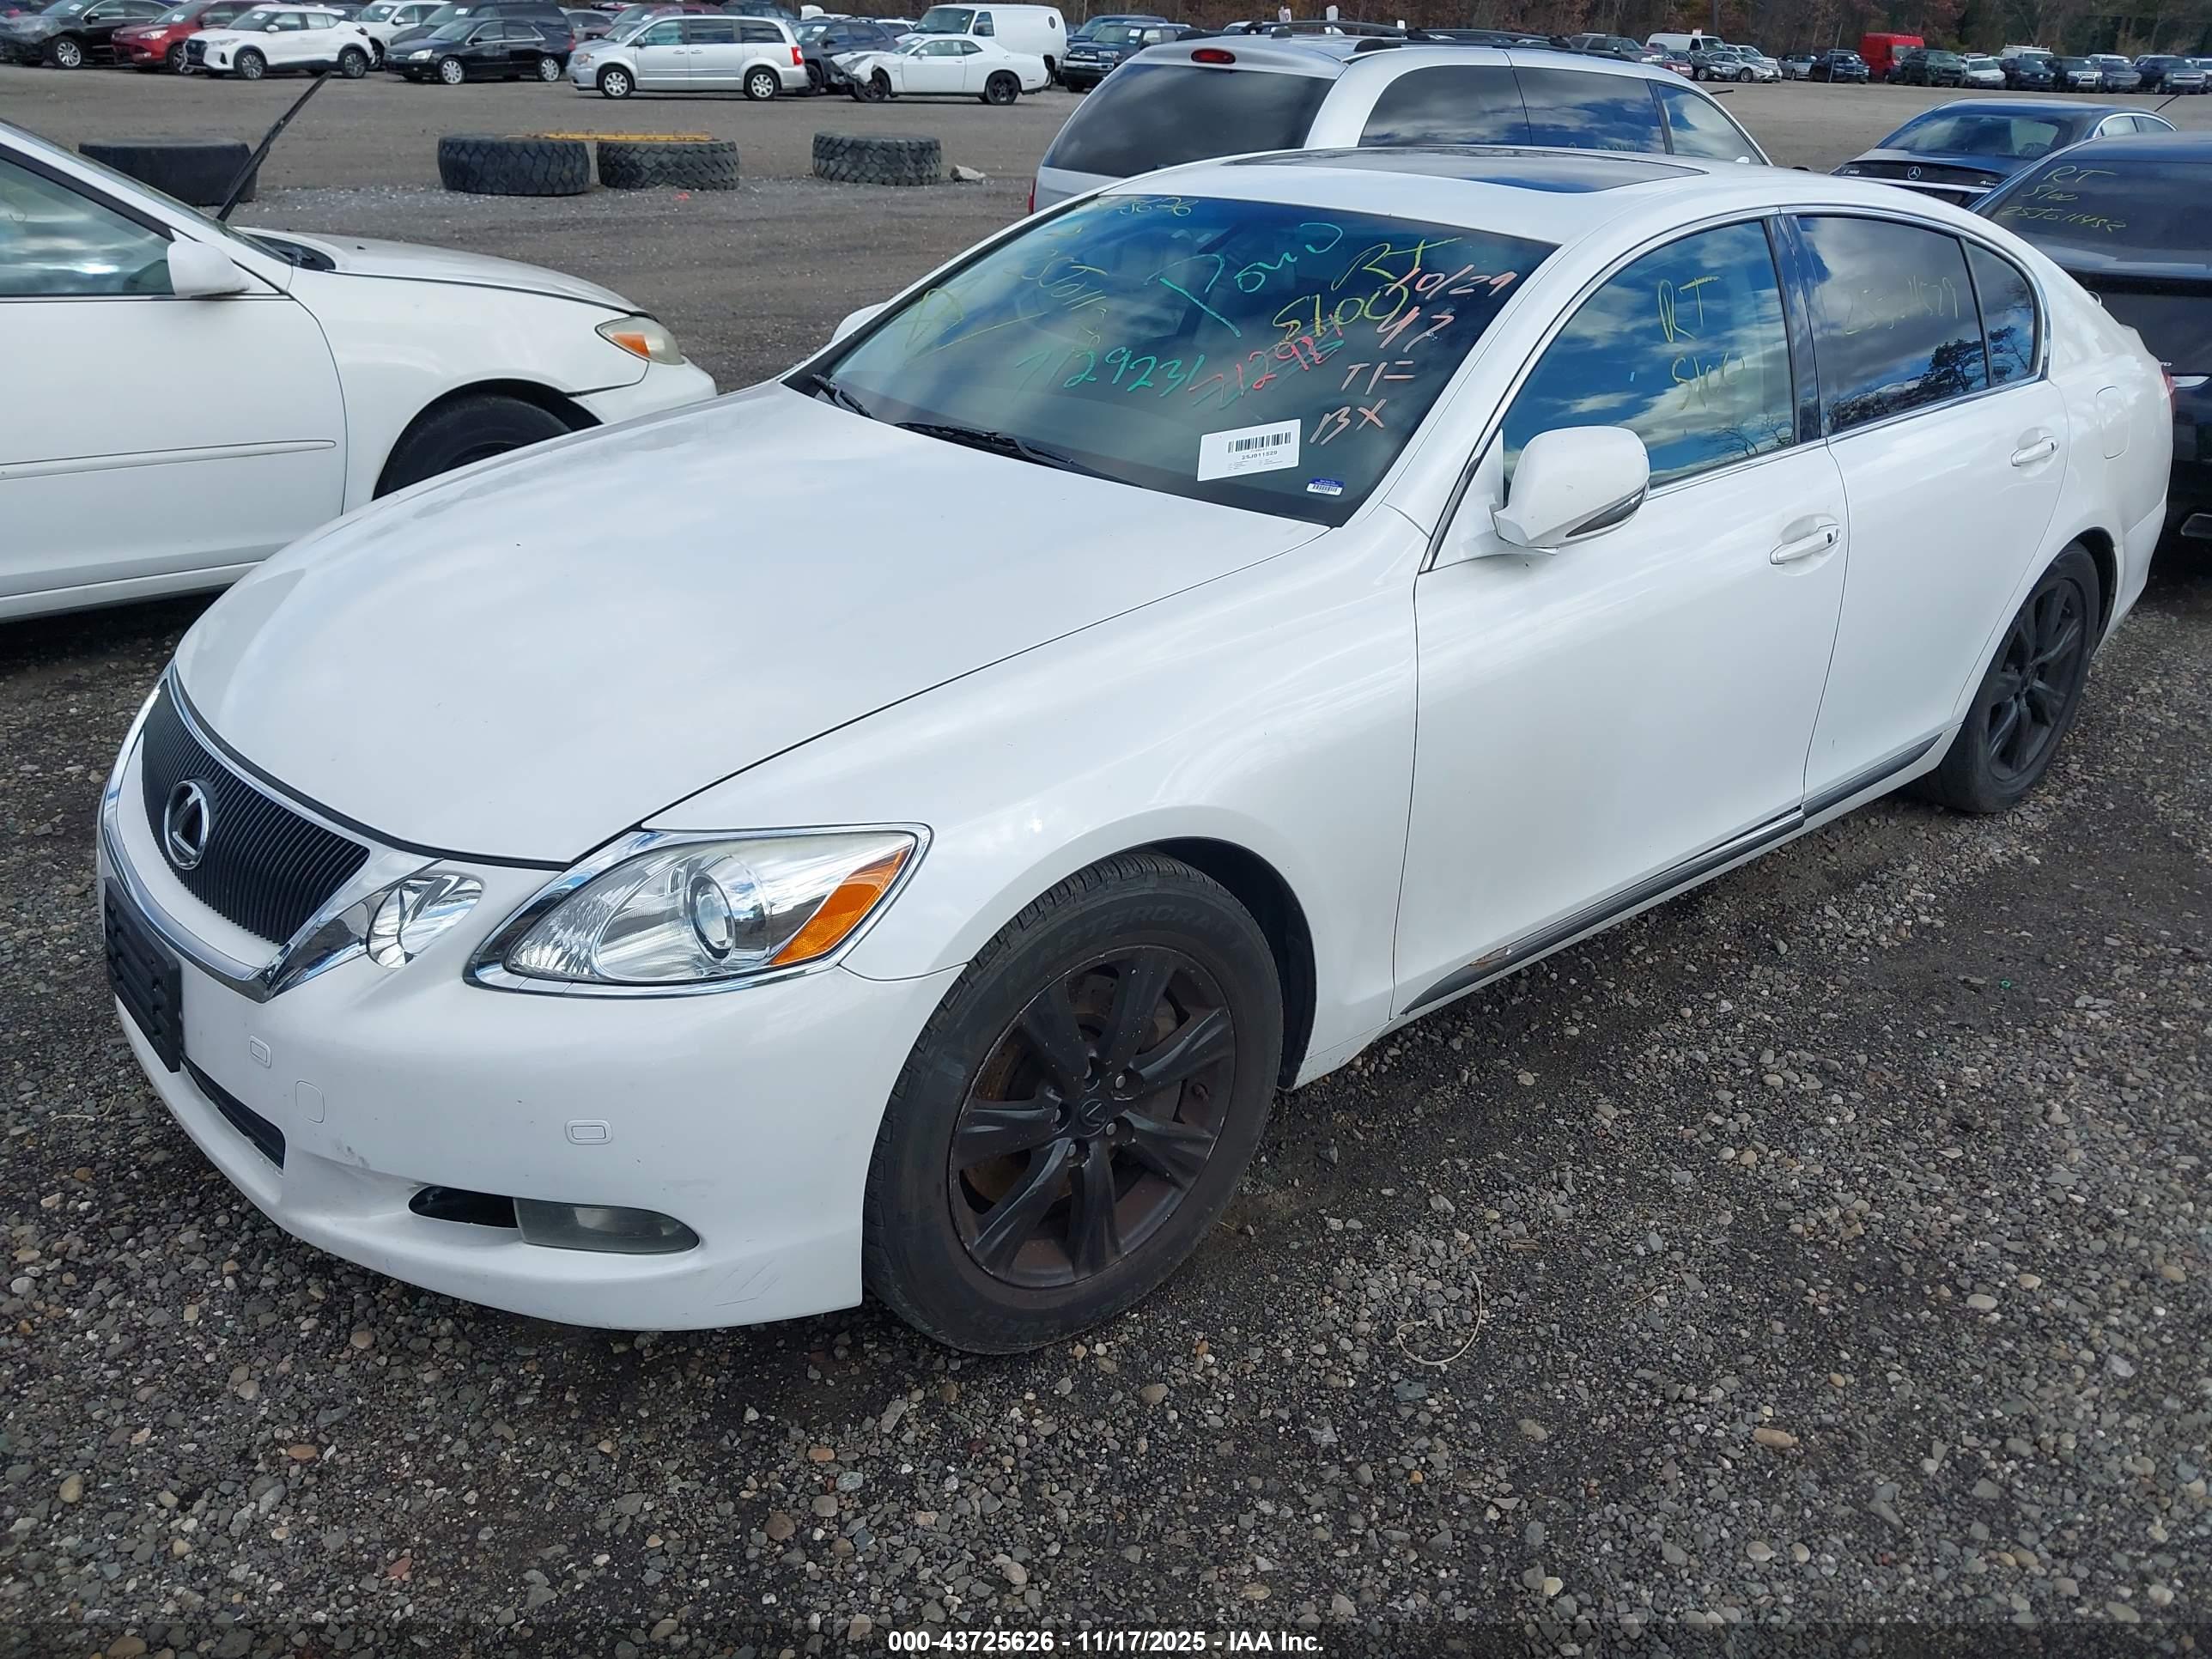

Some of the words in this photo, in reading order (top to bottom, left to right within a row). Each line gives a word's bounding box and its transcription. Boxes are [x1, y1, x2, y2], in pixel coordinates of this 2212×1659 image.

[2042, 165, 2119, 184] RT
[1331, 236, 1462, 291] RT
[1657, 276, 1723, 343] RT
